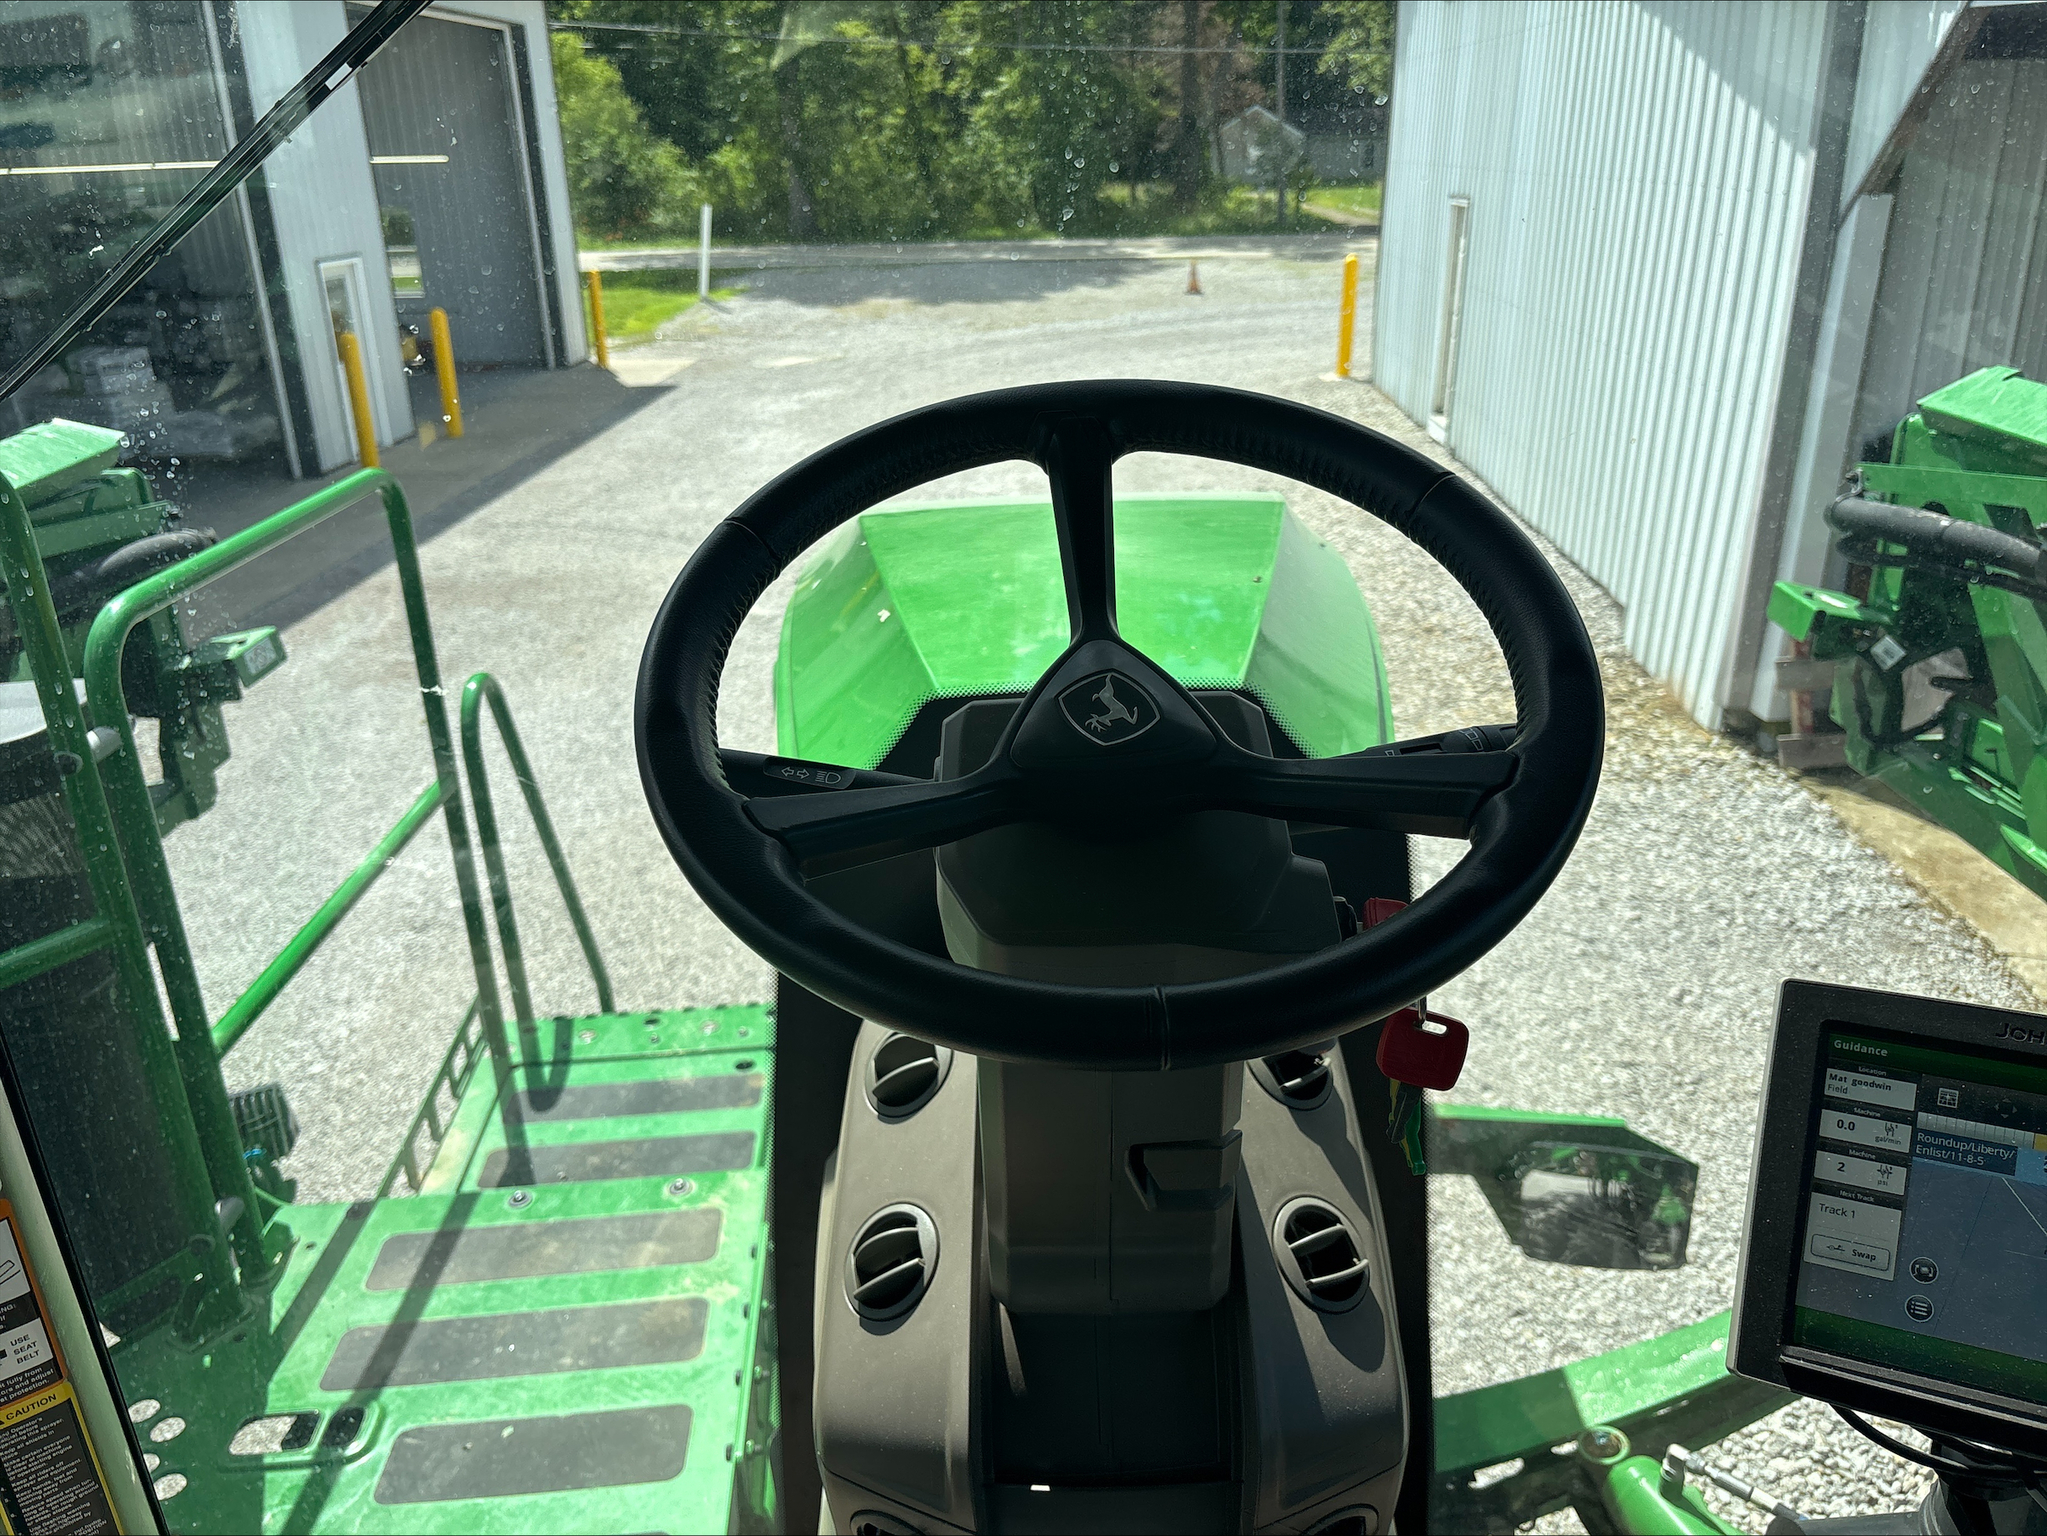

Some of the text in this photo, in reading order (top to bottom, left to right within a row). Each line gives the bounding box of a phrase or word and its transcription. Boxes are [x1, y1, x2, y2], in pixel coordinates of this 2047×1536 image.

[1995, 1022, 2047, 1046] JOH
[1834, 1039, 1888, 1057] Guidance
[1858, 1066, 1887, 1076] Location
[1827, 1083, 1849, 1094] Field
[1829, 1073, 1892, 1091] Mat goodwin
[1853, 1107, 1881, 1118] Machine
[1836, 1119, 1855, 1131] 0.0
[1875, 1136, 1901, 1145] gal/min
[1917, 1132, 2016, 1160] Roundup/Liberty/
[1848, 1149, 1876, 1160] Machine
[1836, 1161, 1846, 1173] 2
[1839, 1189, 1875, 1202] Next Track
[1819, 1202, 1856, 1219] Track 1
[1851, 1248, 1877, 1263] Swap
[10, 1334, 30, 1346] USE
[13, 1341, 37, 1355] SEAT
[17, 1349, 39, 1364] BELT
[6, 1376, 23, 1386] fully
[24, 1367, 42, 1378] from
[15, 1379, 29, 1389] and
[31, 1368, 53, 1382] adjust
[9, 1379, 49, 1400] protection.
[6, 1394, 57, 1420] CAUTION
[21, 1448, 42, 1460] certain
[43, 1435, 70, 1450] everyone
[36, 1445, 61, 1459] machine
[7, 1445, 72, 1476] before starting engine
[11, 1478, 27, 1487] Keep
[37, 1466, 55, 1476] riders
[13, 1480, 36, 1492] sprayer
[16, 1489, 31, 1498] Keep
[18, 1475, 73, 1503] clothing away from
[19, 1495, 42, 1507] moving
[22, 1501, 45, 1513] Reduce
[46, 1491, 65, 1503] speed
[65, 1484, 80, 1494] when
[46, 1492, 75, 1508] operating
[73, 1481, 96, 1494] around
[60, 1495, 78, 1506] rough
[77, 1484, 99, 1498] ground
[35, 1513, 51, 1523] steep
[42, 1514, 67, 1527] flashing
[67, 1502, 90, 1515] warning
[57, 1511, 82, 1525] highway
